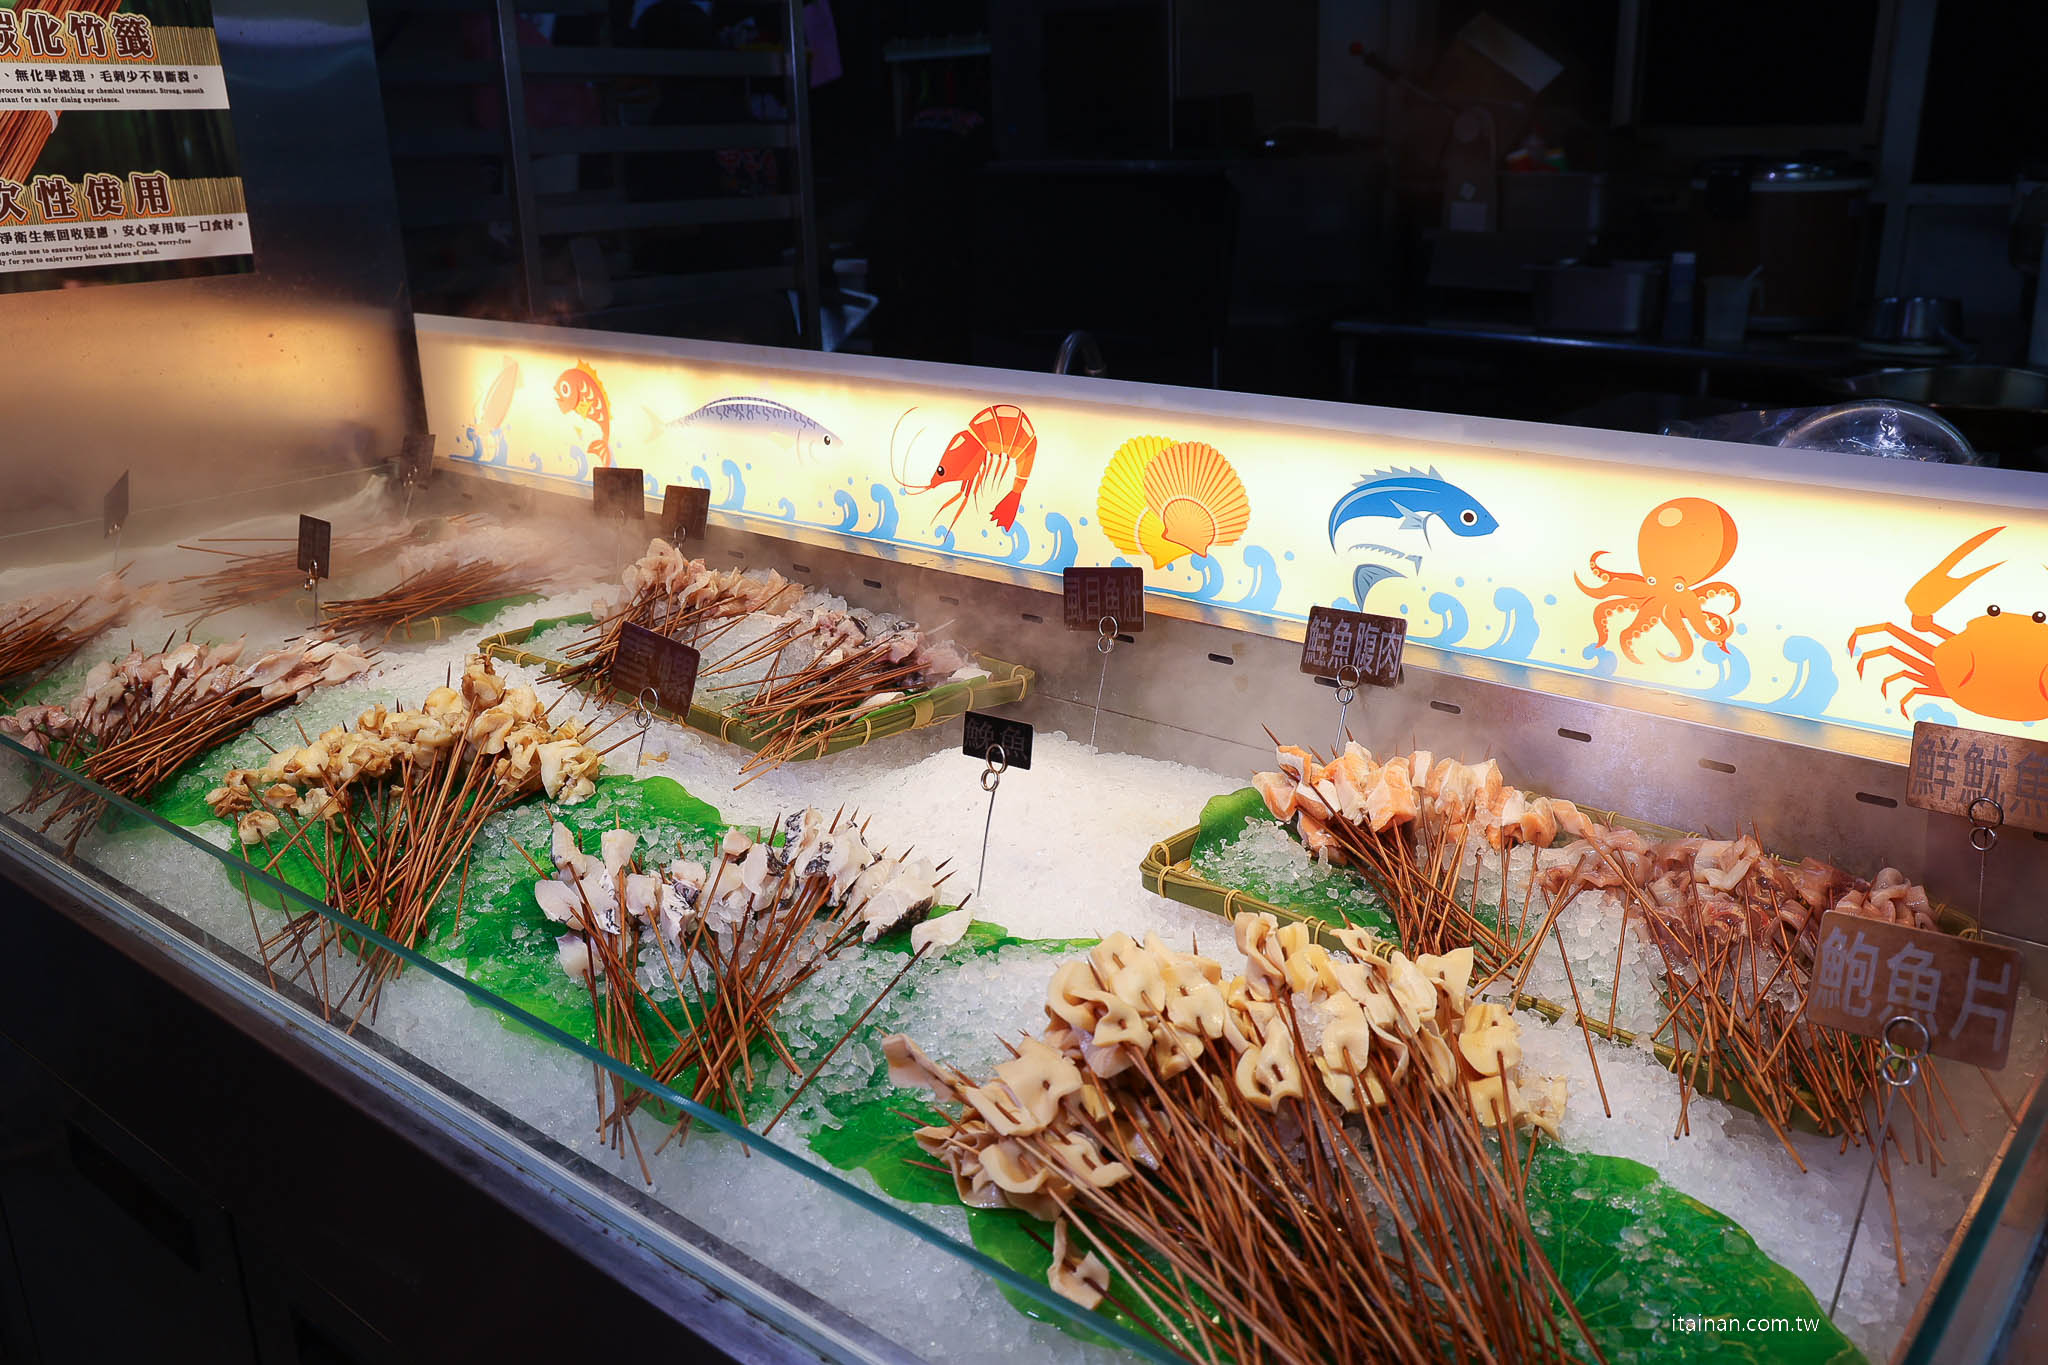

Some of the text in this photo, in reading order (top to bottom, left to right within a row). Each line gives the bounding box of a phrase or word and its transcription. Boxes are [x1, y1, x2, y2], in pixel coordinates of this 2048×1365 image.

[26, 86, 41, 94] with
[54, 87, 85, 95] bleaching
[83, 97, 119, 105] experience.
[114, 240, 135, 249] safety.
[136, 239, 157, 248] Clean,
[158, 238, 192, 246] worry-free
[99, 251, 112, 259] with
[114, 250, 131, 258] peace
[142, 248, 160, 256] mind.
[1304, 615, 1403, 678] 鮭魚腹肉
[1813, 927, 2012, 1051] 鮑魚片
